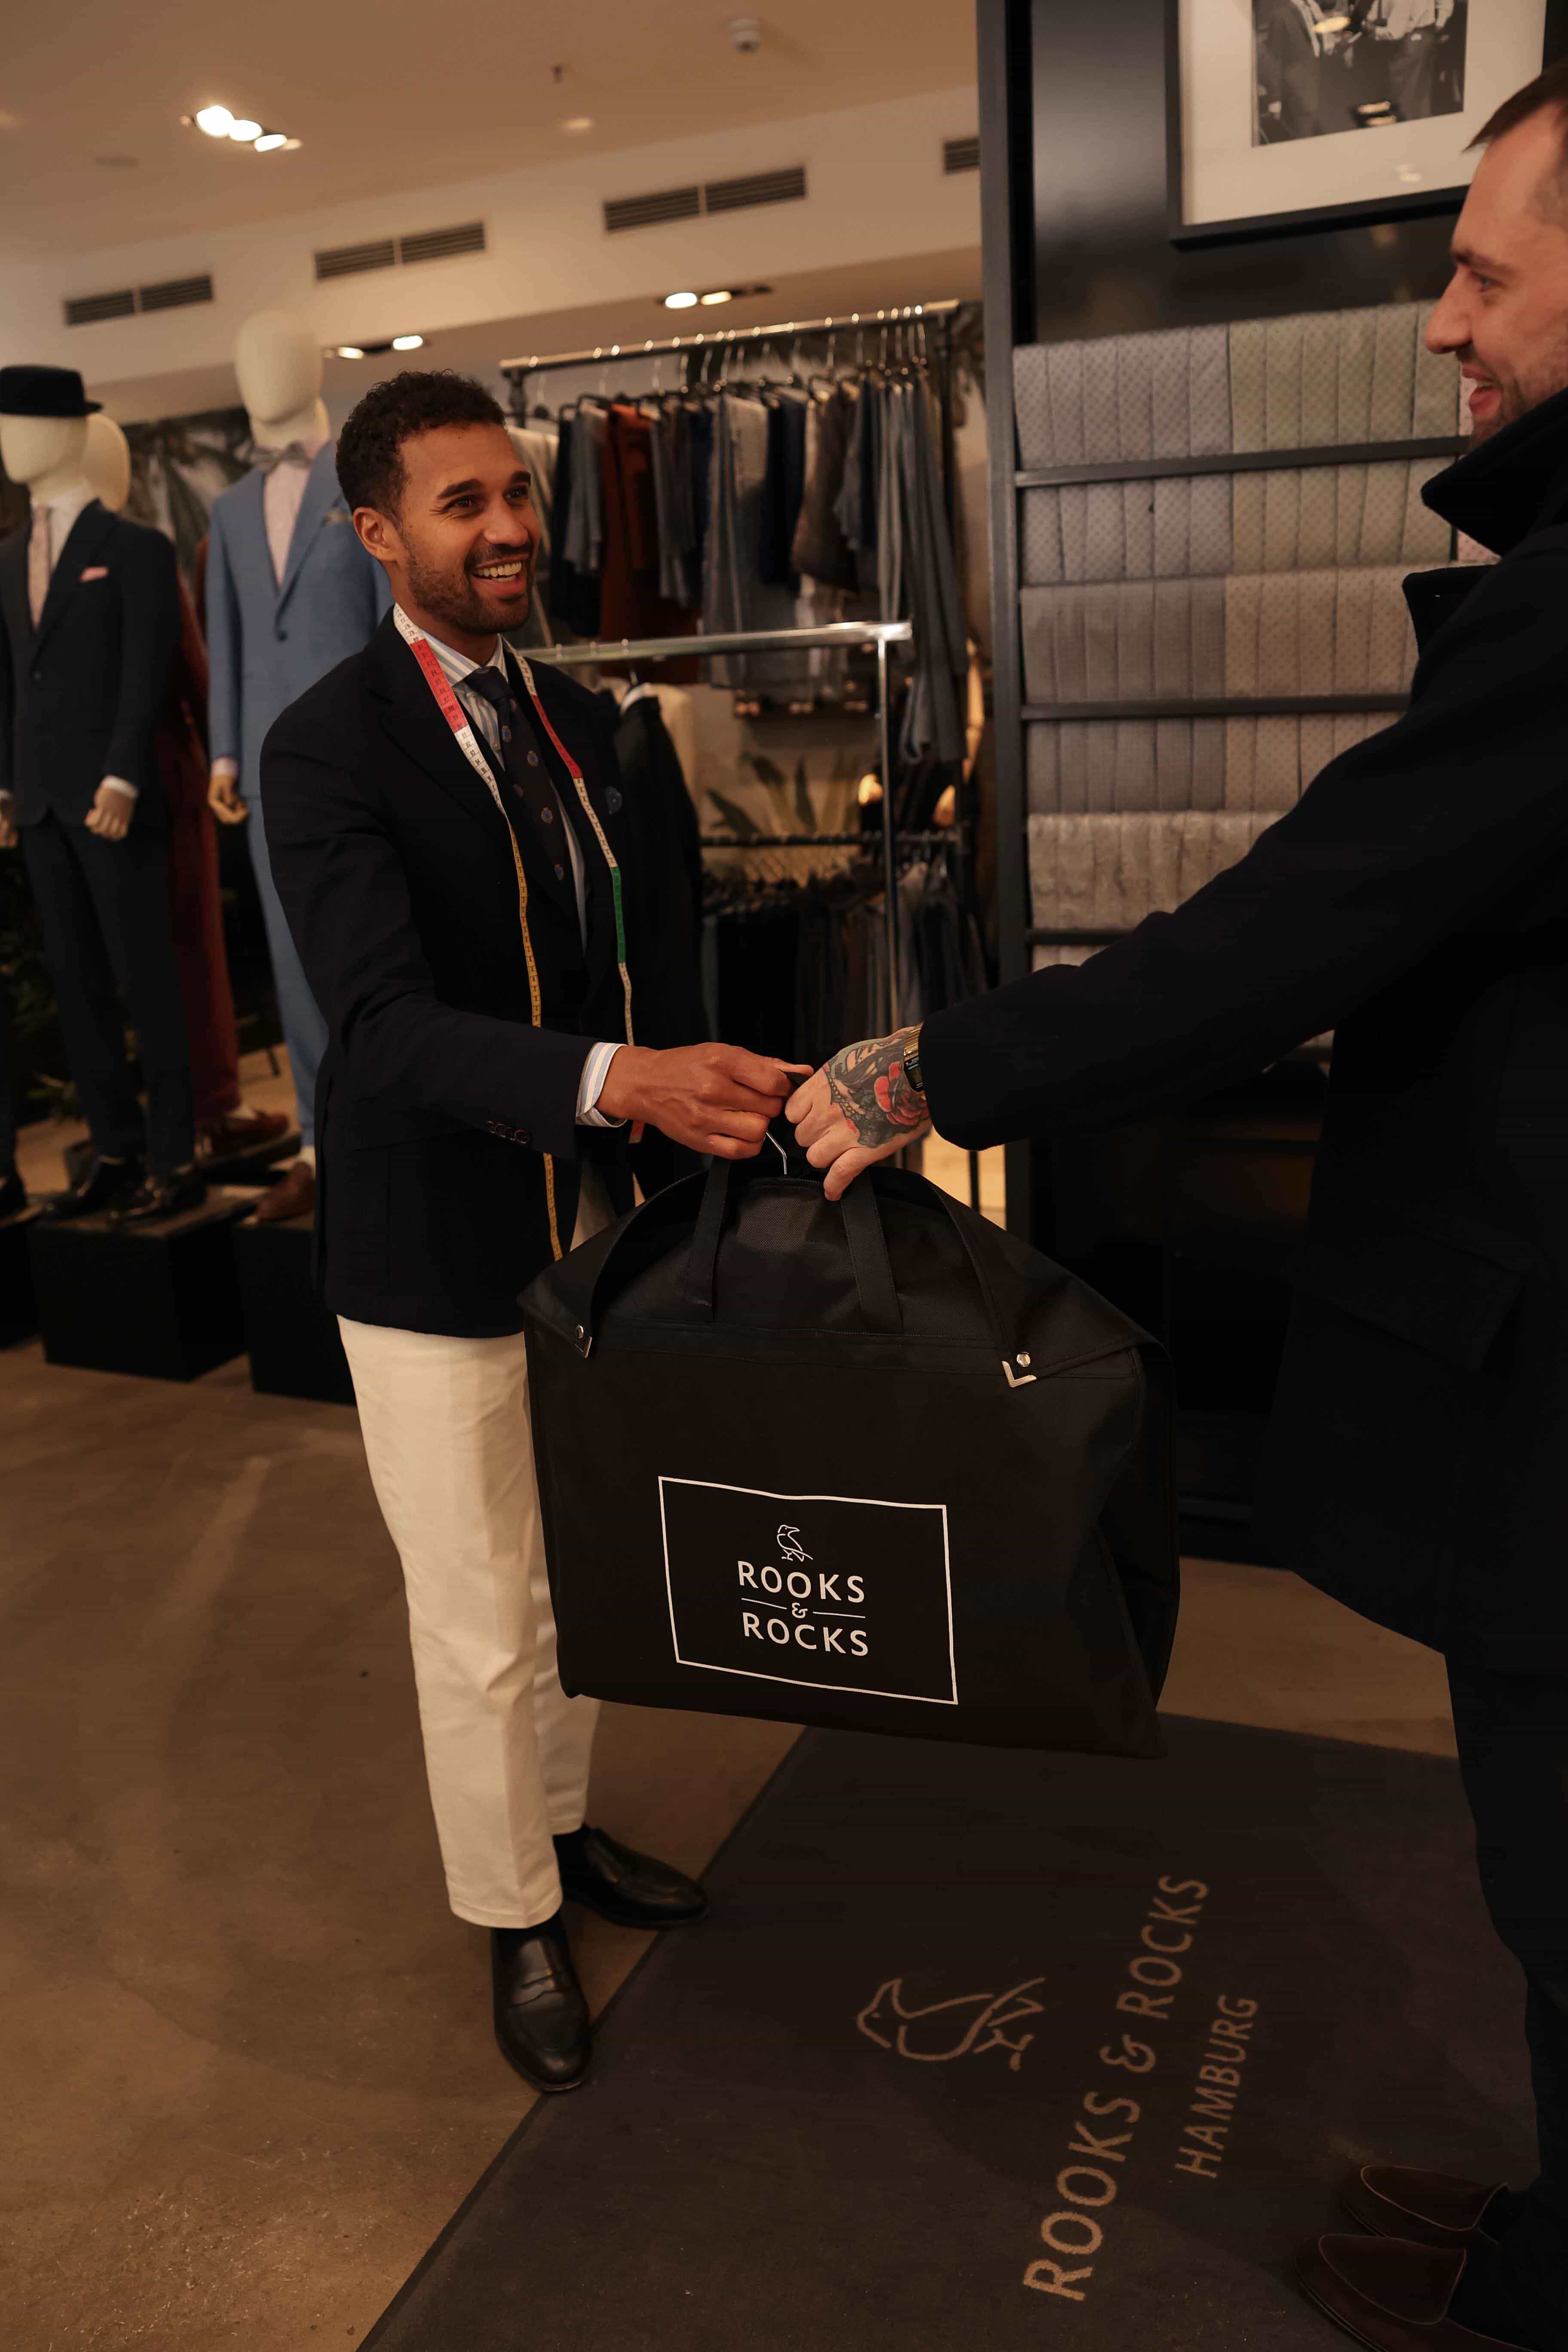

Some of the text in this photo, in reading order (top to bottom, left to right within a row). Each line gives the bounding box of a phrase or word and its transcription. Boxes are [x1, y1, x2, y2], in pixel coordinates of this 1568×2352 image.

[738, 1561, 865, 1603] ROOKS
[791, 1602, 808, 1619] &
[742, 1612, 868, 1656] ROCKS
[1023, 1875, 1208, 2302] ROOKS & ROCKS
[1175, 1994, 1258, 2178] HAMBURG
